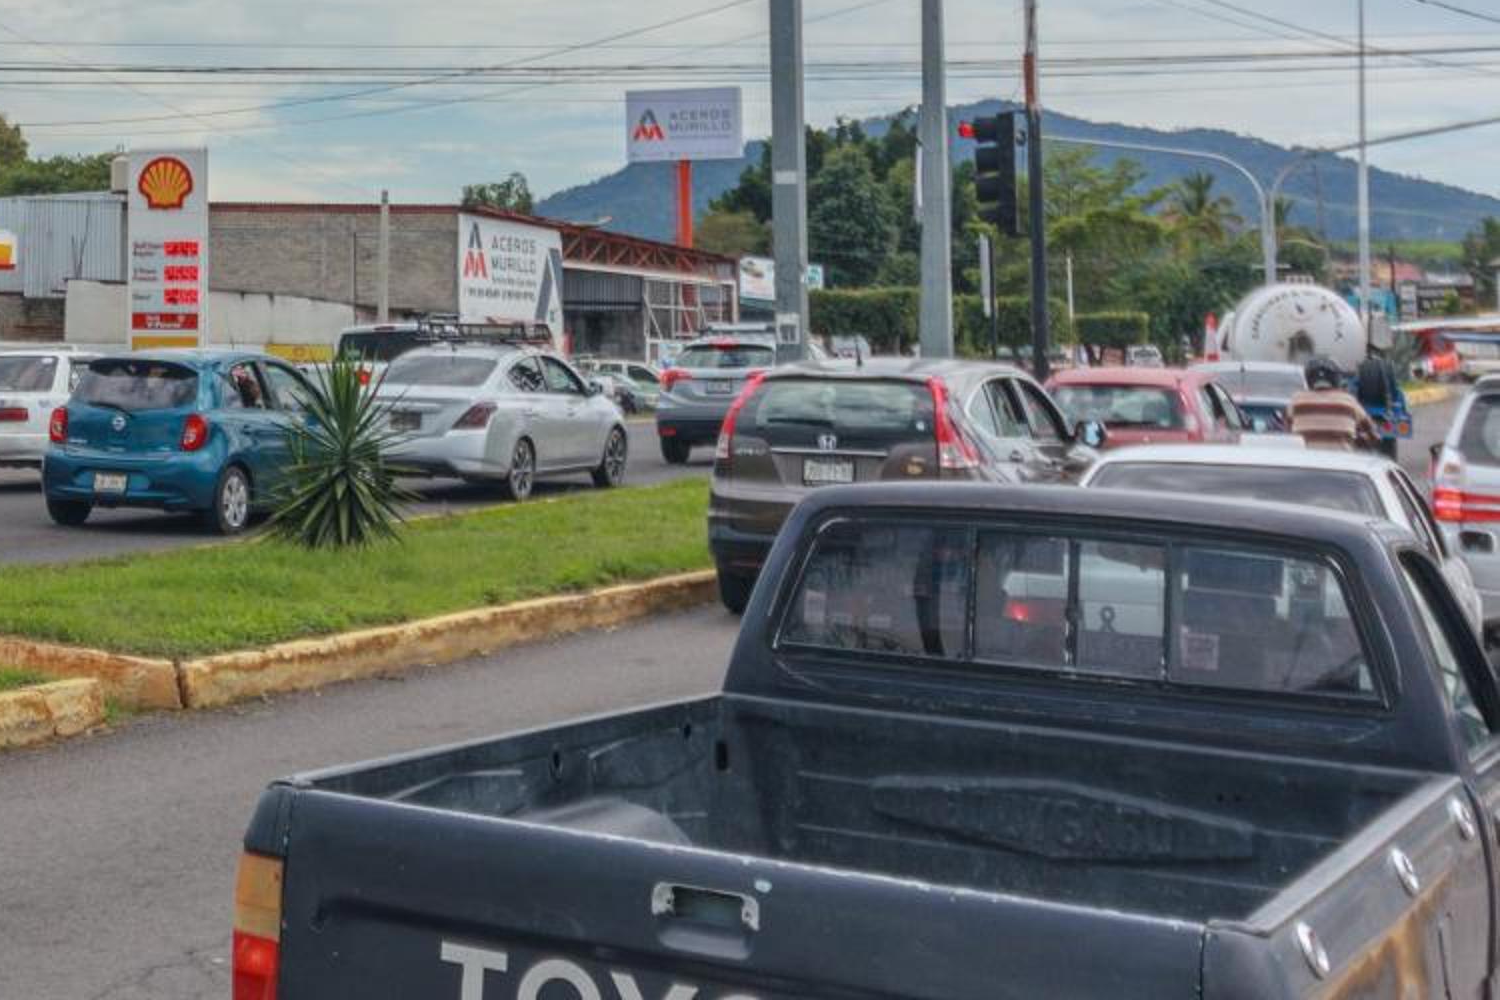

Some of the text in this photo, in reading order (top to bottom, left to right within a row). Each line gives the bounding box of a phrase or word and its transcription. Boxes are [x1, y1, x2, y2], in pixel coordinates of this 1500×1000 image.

[669, 108, 731, 121] ACEROS
[491, 234, 537, 255] ACEROS
[491, 254, 537, 274] MURILLO
